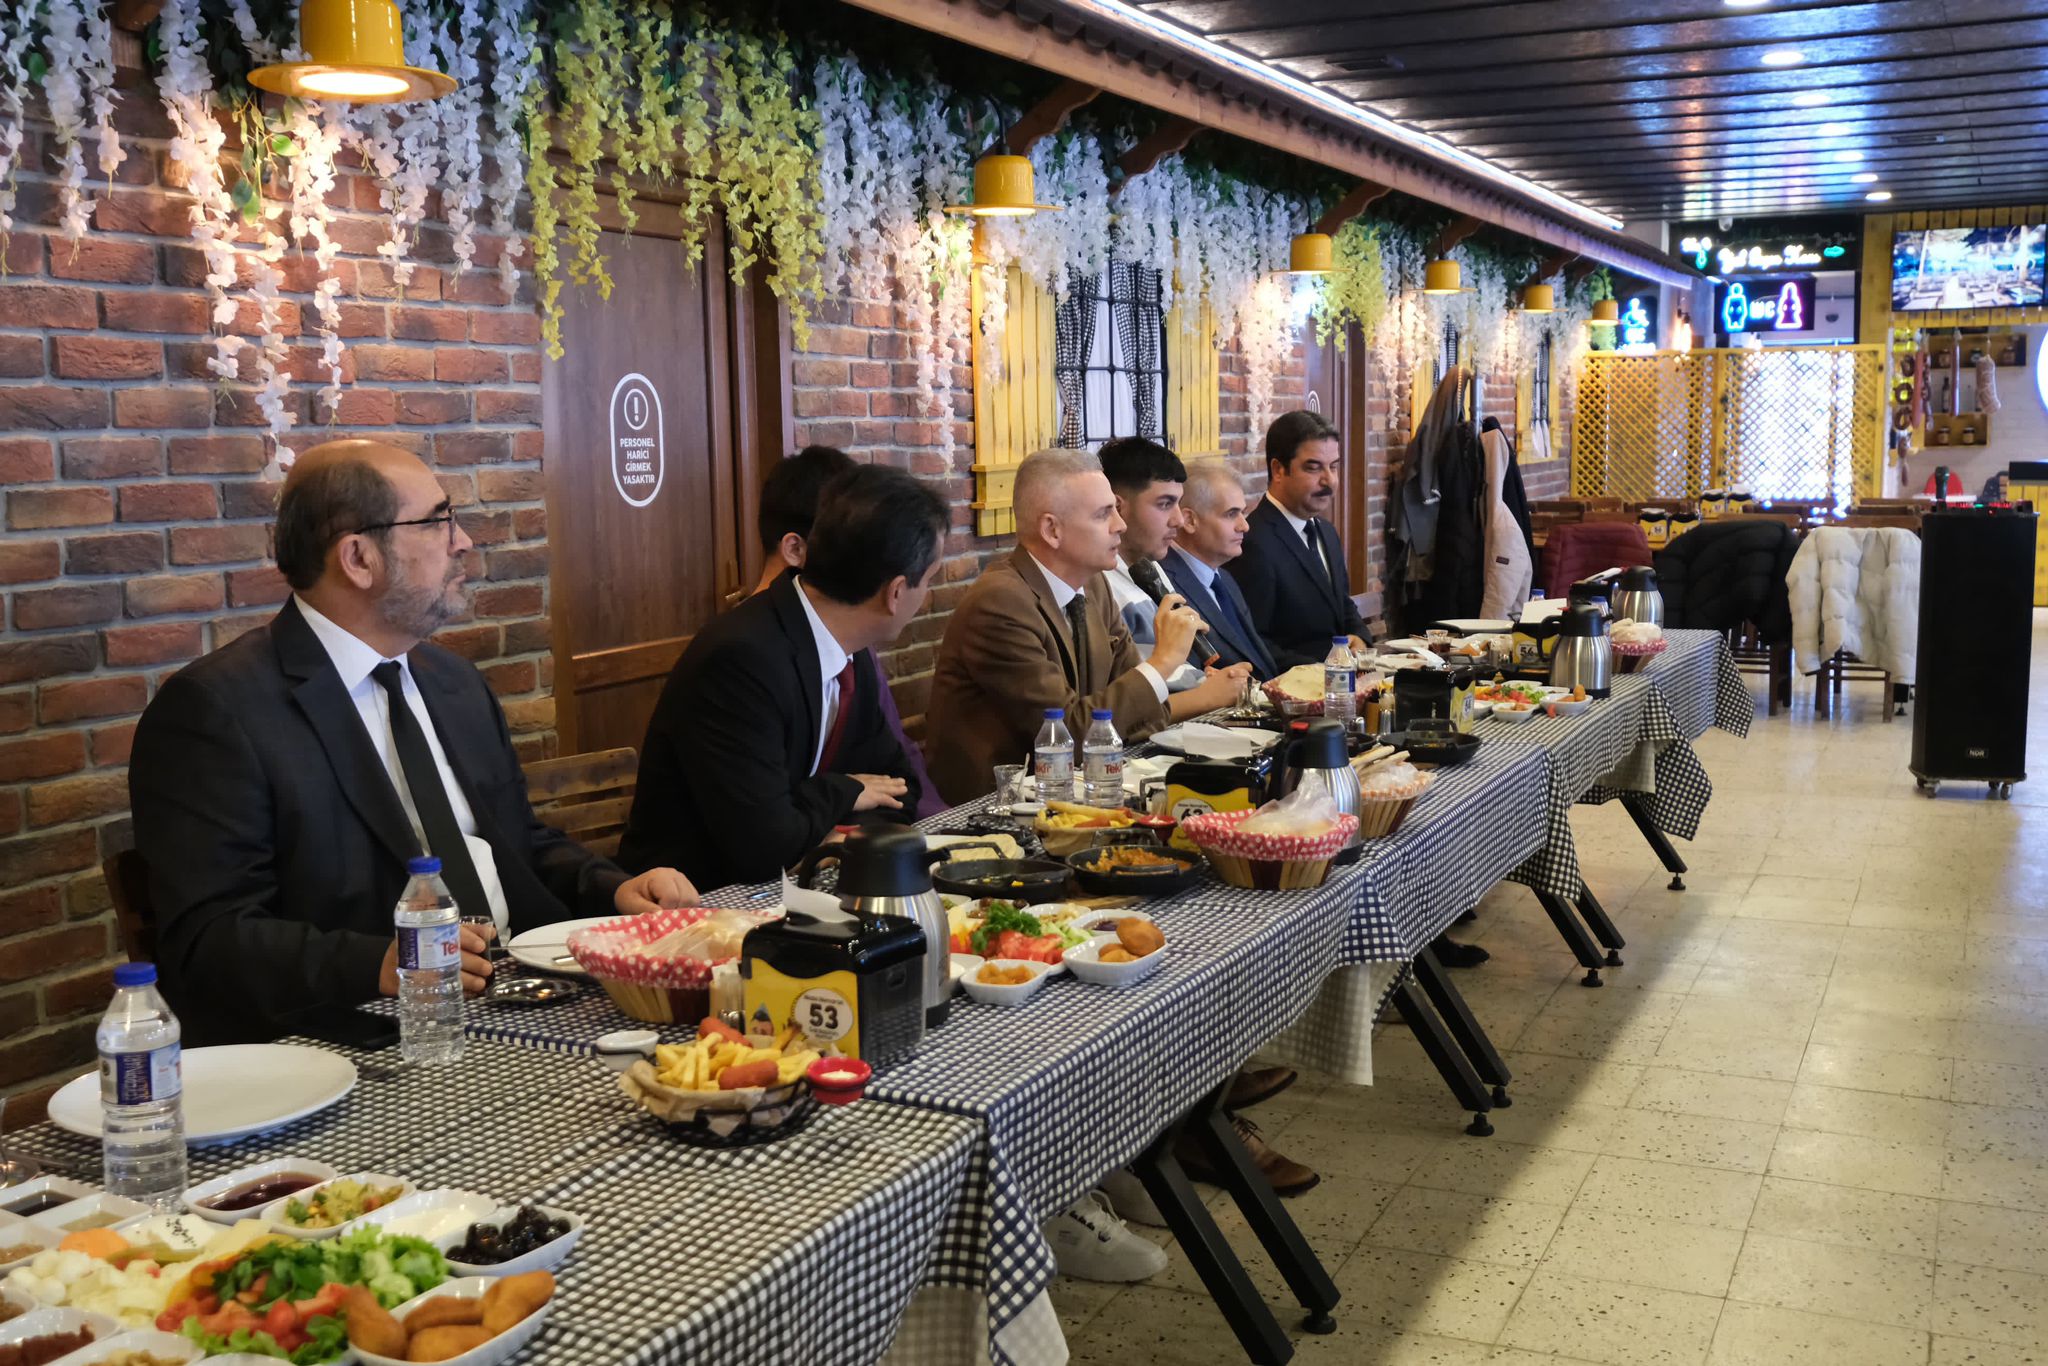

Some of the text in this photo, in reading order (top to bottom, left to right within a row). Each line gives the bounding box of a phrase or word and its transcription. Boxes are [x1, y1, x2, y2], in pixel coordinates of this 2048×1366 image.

[1750, 301, 1776, 319] WC
[619, 437, 656, 448] PERSONEL
[626, 448, 650, 460] HARİCİ
[625, 461, 652, 472] GİRMEK
[622, 474, 656, 485] YASAKTIR
[808, 1003, 839, 1030] 53
